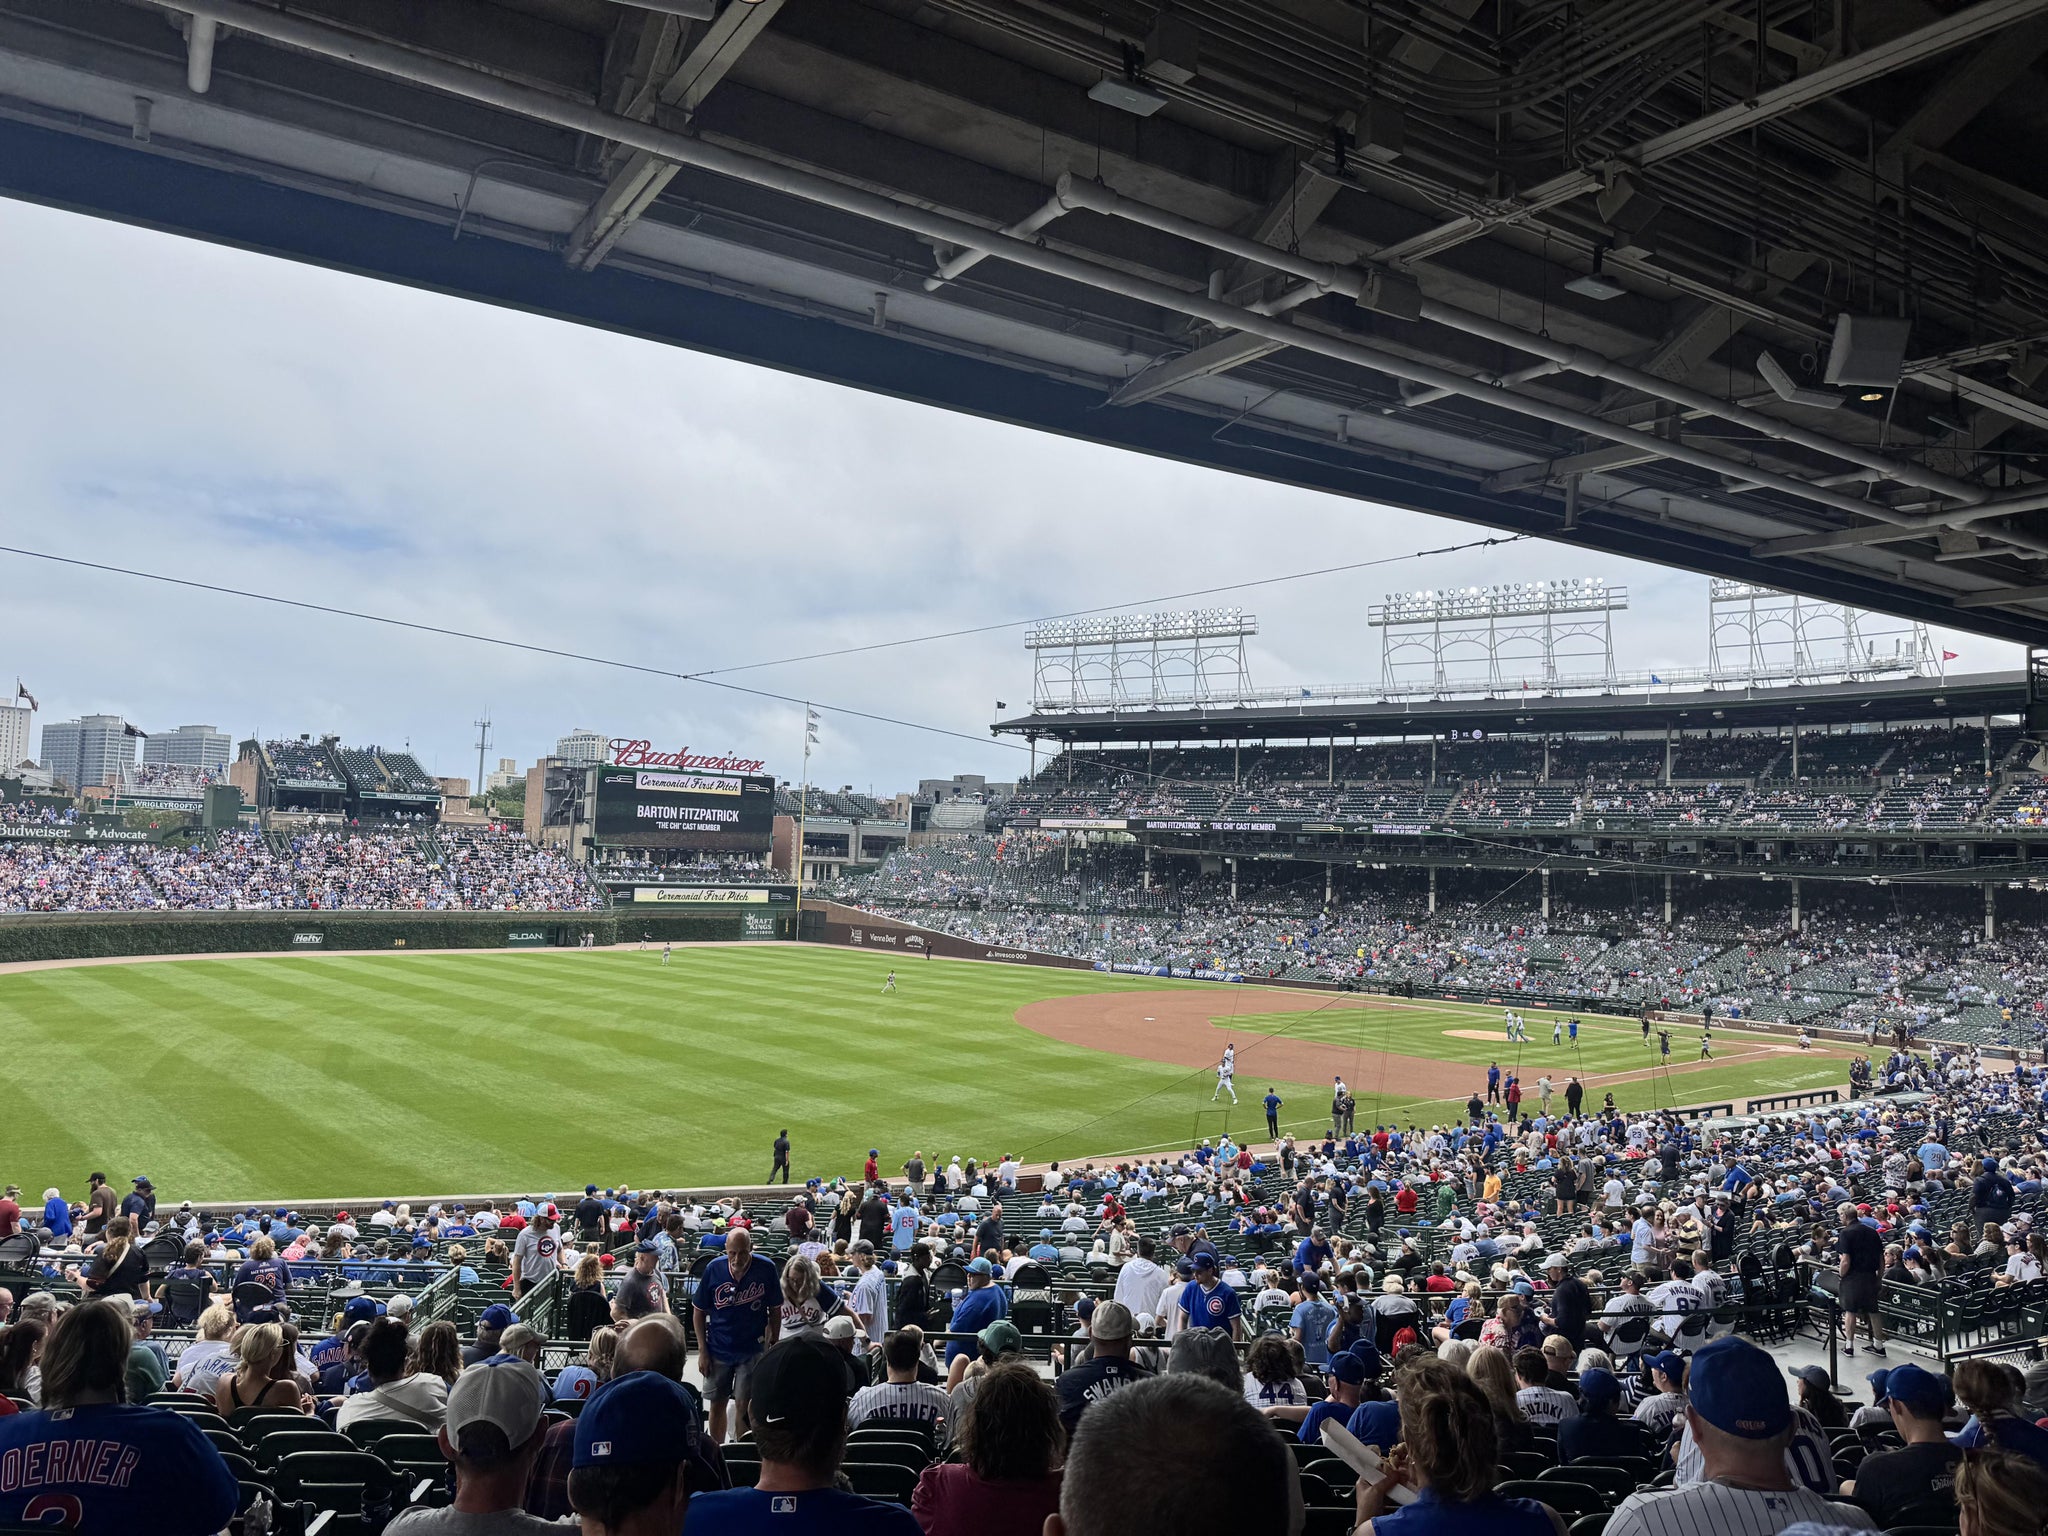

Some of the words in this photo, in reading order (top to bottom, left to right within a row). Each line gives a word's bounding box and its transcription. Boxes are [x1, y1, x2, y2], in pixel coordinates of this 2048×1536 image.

[609, 738, 765, 773] Budweiser
[640, 774, 690, 789] Ceremonial
[690, 777, 714, 790] First
[715, 779, 738, 792] Pitch
[636, 805, 679, 819] BARTON
[679, 807, 740, 823] FITZPATRICK
[682, 822, 697, 831] CAST
[697, 823, 721, 832] MEMBER
[1146, 821, 1167, 829] BARTON
[1167, 821, 1201, 830] FITZPATRICK
[1235, 822, 1251, 831] CAST
[1250, 823, 1277, 831] MEMBER
[100, 828, 147, 839] Advocate
[657, 889, 702, 901] Ceremonial
[703, 890, 726, 901] First
[726, 890, 749, 902] Pitch
[746, 918, 774, 926] DRAFT
[295, 934, 321, 943] Hefty
[869, 933, 885, 943] Vienna
[885, 934, 897, 945] Beef
[904, 935, 925, 946] MARQUEE
[994, 951, 1015, 959] Invesco
[1131, 965, 1150, 975] Wrap
[1204, 970, 1225, 980] Wrap
[901, 1216, 915, 1228] 65
[255, 1272, 276, 1289] 23
[1259, 1382, 1295, 1405] 44
